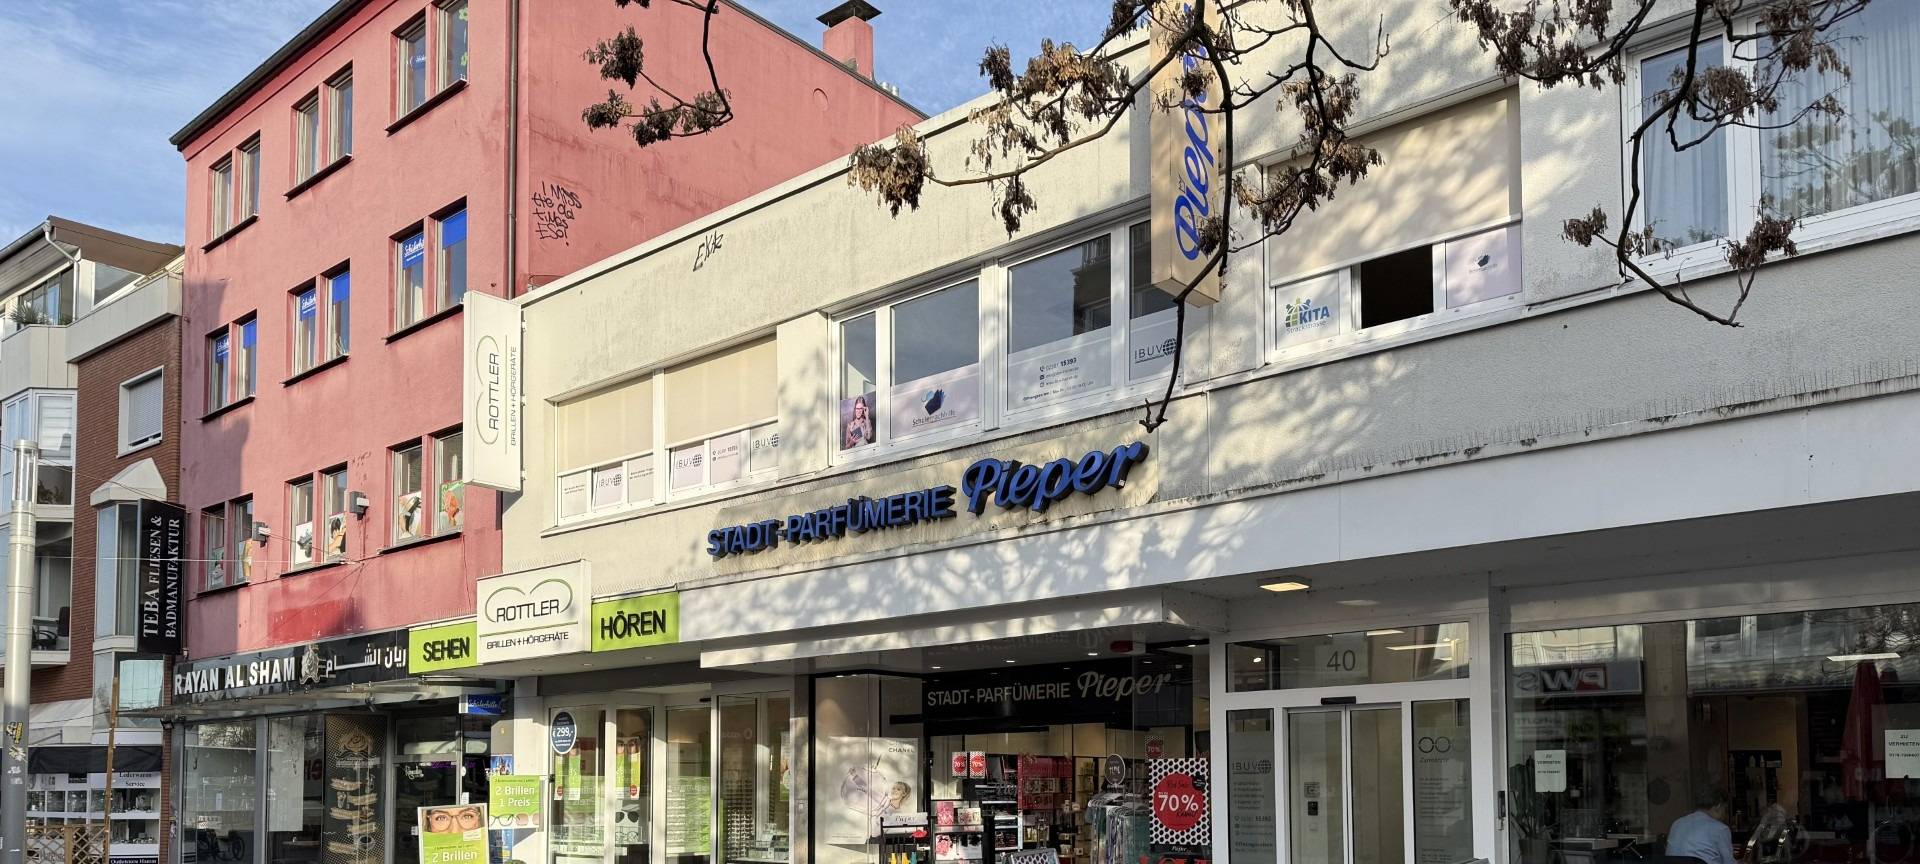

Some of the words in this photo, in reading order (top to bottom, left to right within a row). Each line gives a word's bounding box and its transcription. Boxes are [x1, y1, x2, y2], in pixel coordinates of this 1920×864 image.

[1299, 306, 1330, 324] KITA
[488, 352, 500, 431] ROTTLER
[707, 484, 956, 558] STADT-PARFÜMERIE
[962, 441, 1150, 514] Pieper
[151, 515, 162, 527] &
[149, 529, 161, 584] FLIESEN
[165, 519, 180, 638] BADMANUFAKTUR
[143, 587, 159, 638] TEBA
[496, 599, 560, 623] ROTTLER
[601, 609, 666, 640] HÖREN
[422, 637, 470, 662] SEHEN
[1326, 649, 1356, 672] 40
[175, 668, 219, 696] RAYAN
[224, 664, 244, 689] AL
[249, 657, 295, 684] SHAM
[927, 682, 1071, 706] STADT-PARFÜMERIE
[1077, 671, 1172, 701] Pieper
[495, 786, 502, 795] 2
[504, 785, 535, 796] Brillen
[508, 797, 531, 807] Preis
[1158, 794, 1199, 812] 70%
[432, 852, 439, 863] 2
[442, 849, 478, 862] Brillen
